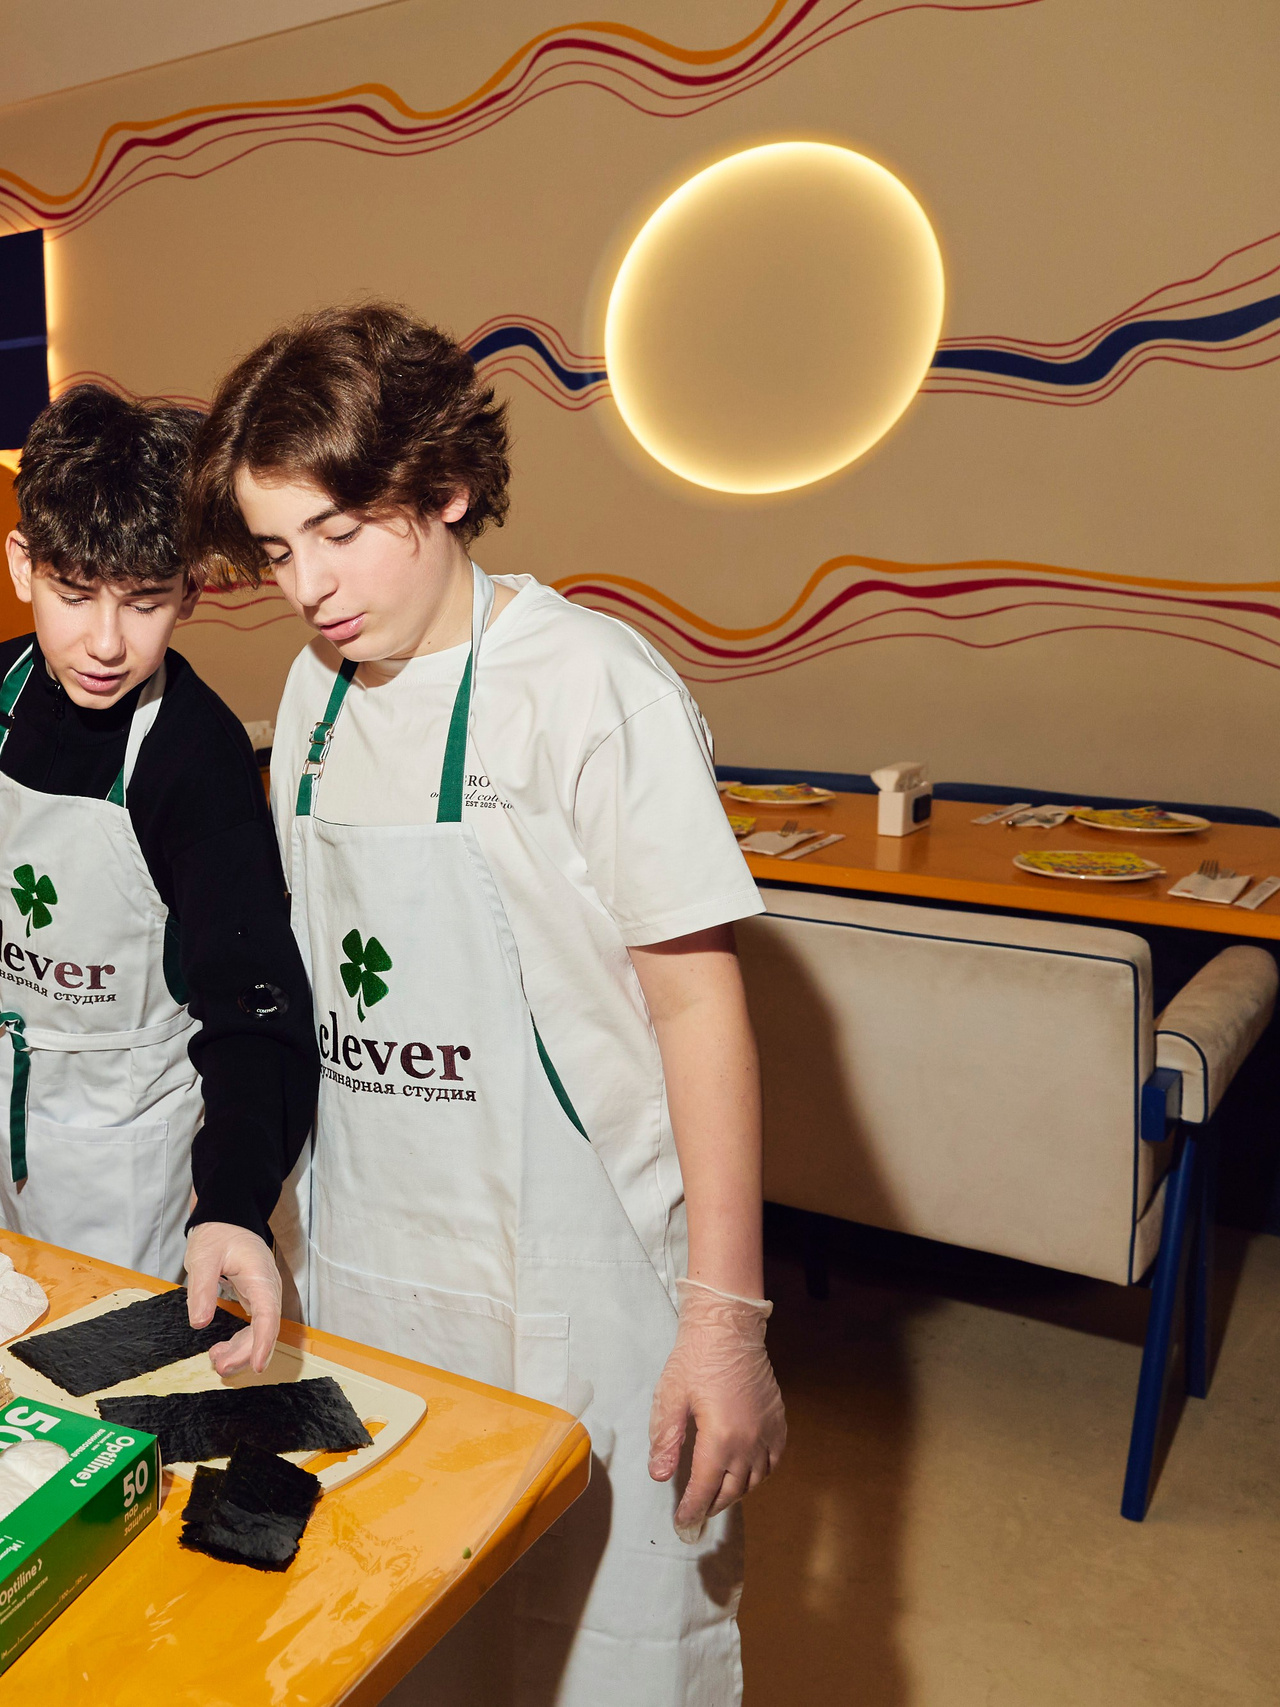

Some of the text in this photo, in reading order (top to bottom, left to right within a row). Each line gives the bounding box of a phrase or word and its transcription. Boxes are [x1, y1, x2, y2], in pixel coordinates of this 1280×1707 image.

[464, 775, 491, 788] RO
[465, 800, 497, 809] EST 2025
[53, 991, 117, 1006] студия
[320, 1010, 472, 1082] clever
[402, 1083, 478, 1103] студия
[76, 1436, 135, 1480] Optiline
[123, 1460, 149, 1508] 50
[124, 1503, 139, 1522] пар
[124, 1502, 152, 1536] защиты
